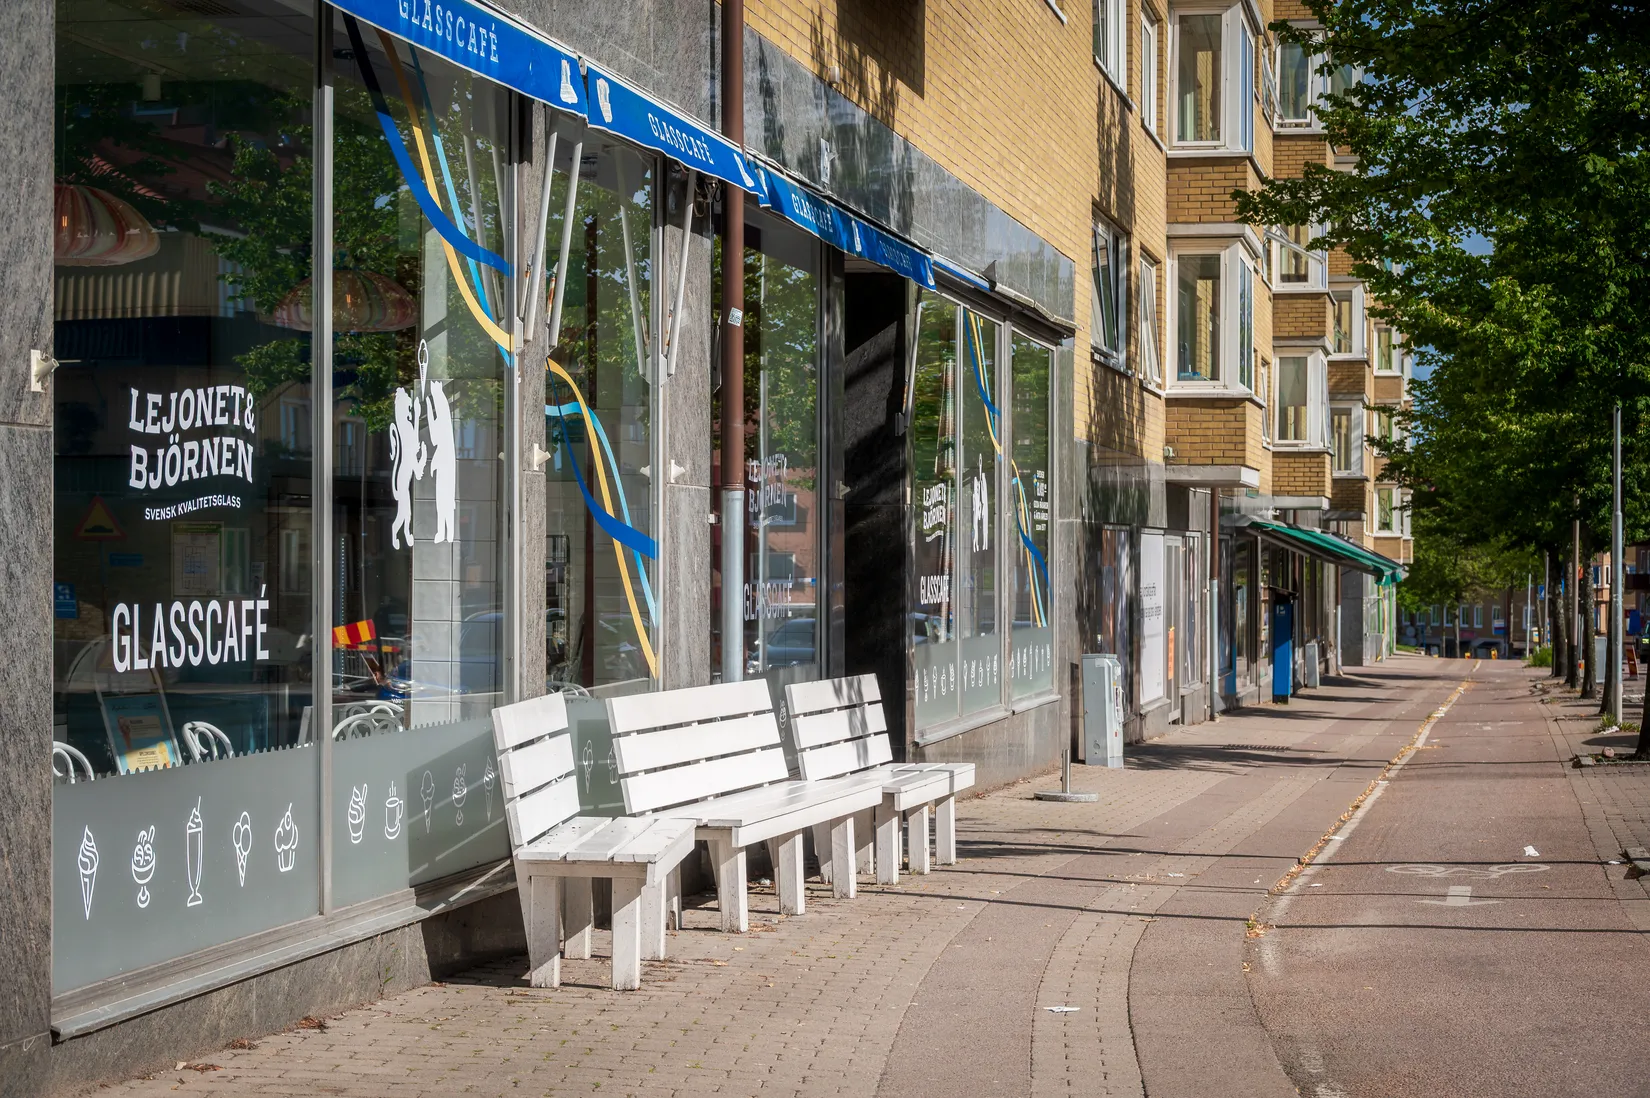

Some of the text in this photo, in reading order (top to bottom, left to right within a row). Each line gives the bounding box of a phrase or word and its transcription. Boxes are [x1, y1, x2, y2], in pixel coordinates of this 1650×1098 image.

[398, 0, 499, 63] GLASSCAFÉ
[647, 112, 715, 166] GLASSCAFÉ
[791, 192, 834, 233] GLASSCAFÉ
[129, 432, 254, 490] BJÖRNEN
[144, 494, 241, 521] SVENSK KVALITETSGLASS
[744, 573, 793, 621] GLASSCAFÉ
[112, 583, 270, 673] GLASSCAFÉ
